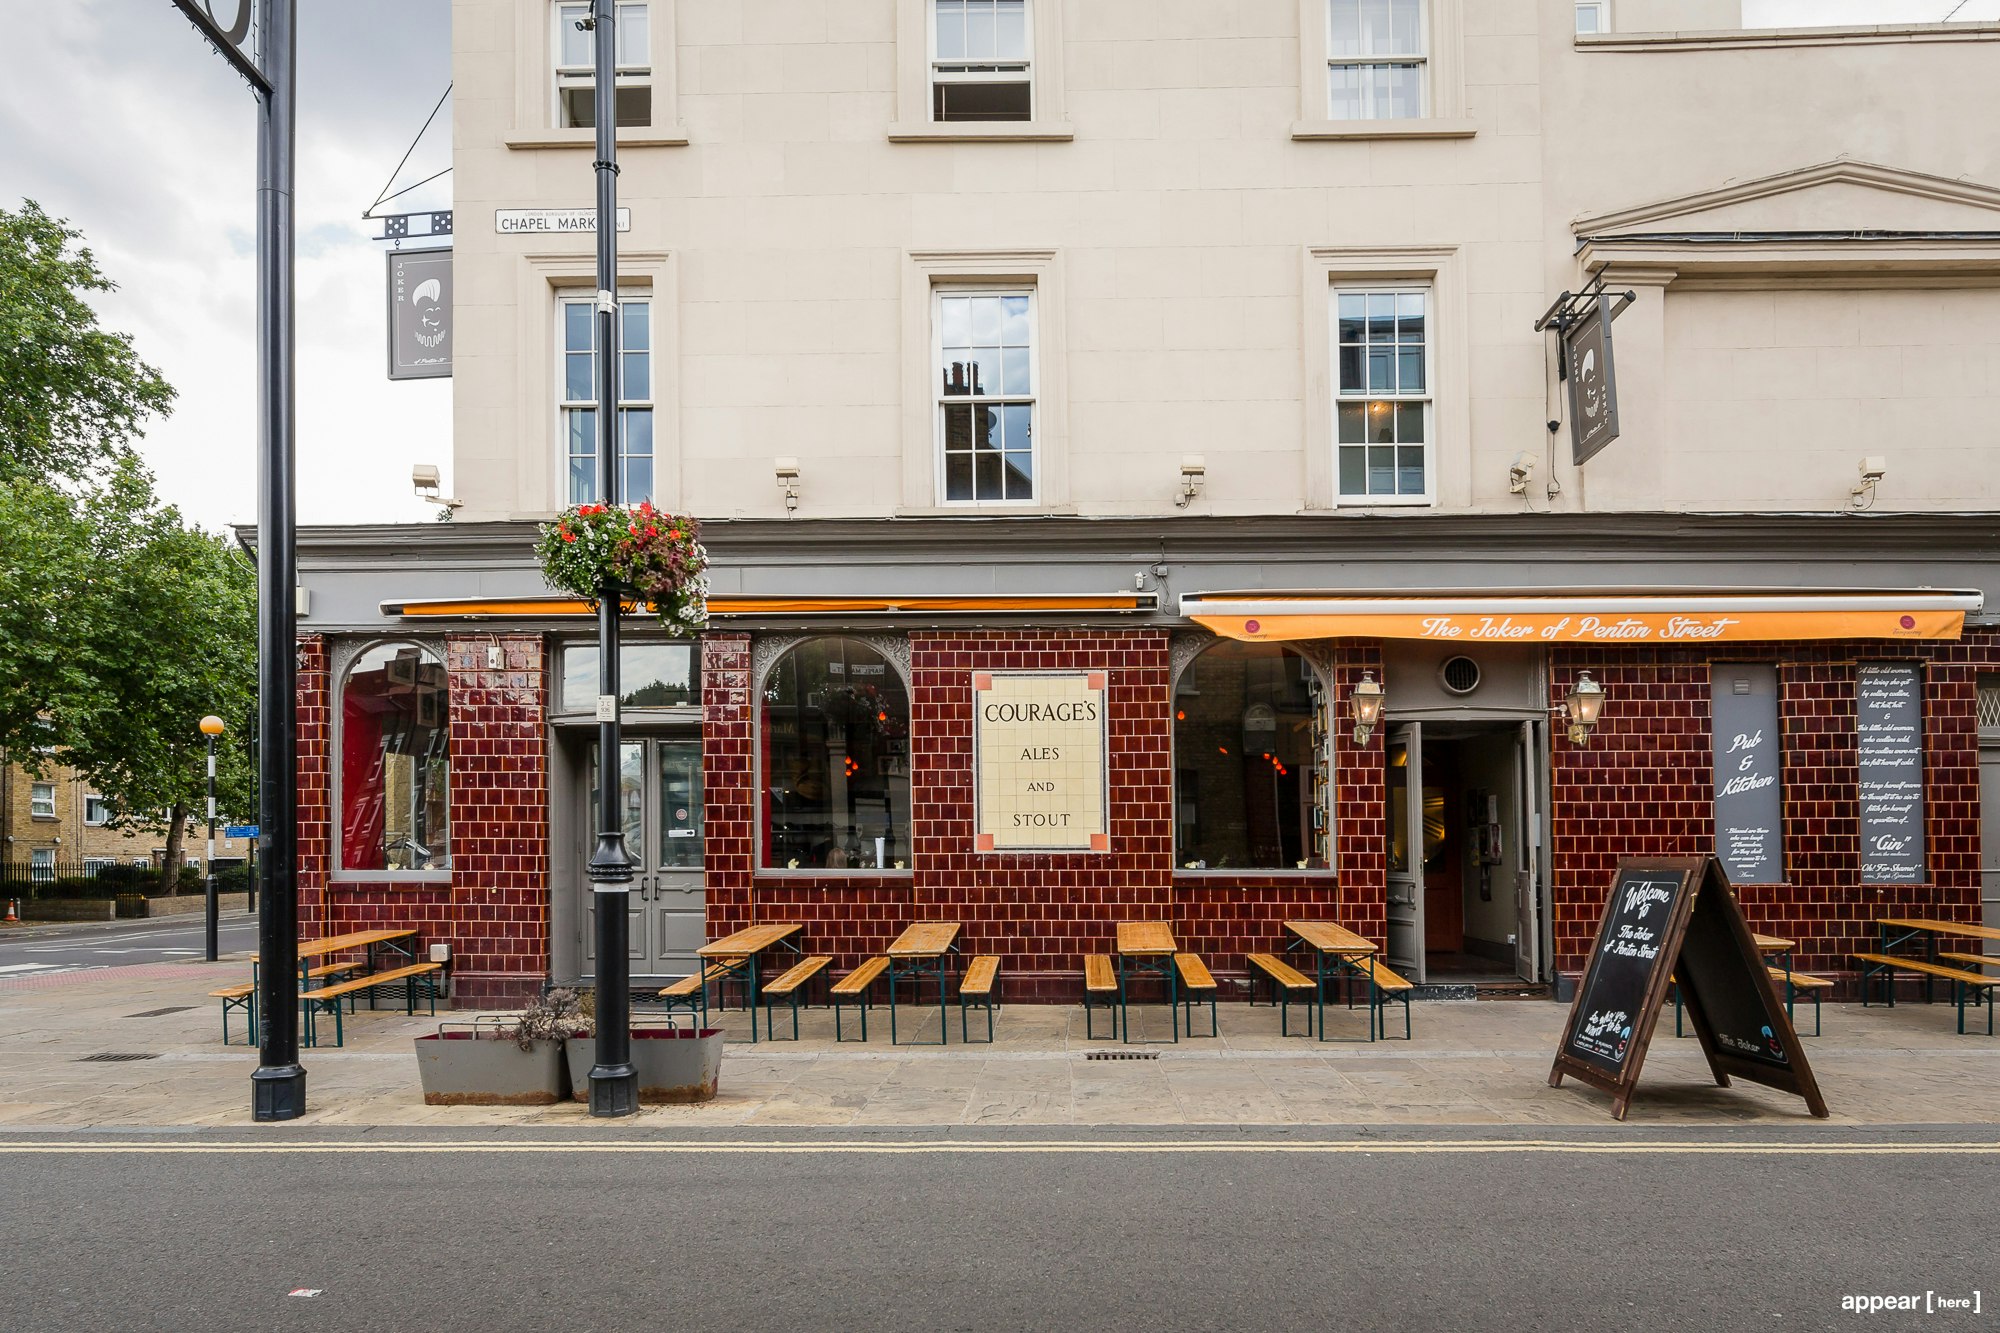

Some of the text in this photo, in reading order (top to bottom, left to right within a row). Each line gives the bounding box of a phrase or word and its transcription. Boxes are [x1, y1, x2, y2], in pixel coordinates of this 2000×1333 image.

[501, 218, 551, 230] CHAPEL
[558, 218, 596, 229] MARK
[397, 262, 405, 301] JOKER
[1420, 616, 1740, 640] The Joker of Penton Street
[985, 700, 1096, 722] COURAGE'S
[1726, 729, 1762, 754] Pub
[1020, 748, 1060, 760] ALES
[1738, 754, 1753, 771] &
[1027, 782, 1055, 792] AND
[1717, 773, 1774, 797] Kitchen
[1013, 814, 1070, 826] STOUT
[1875, 864, 1890, 872] For
[1624, 881, 1669, 913] Welcome
[1638, 902, 1652, 920] to
[1618, 925, 1655, 940] The Joker
[1604, 940, 1659, 959] of Penton Street
[1719, 1033, 1760, 1052] The Joker
